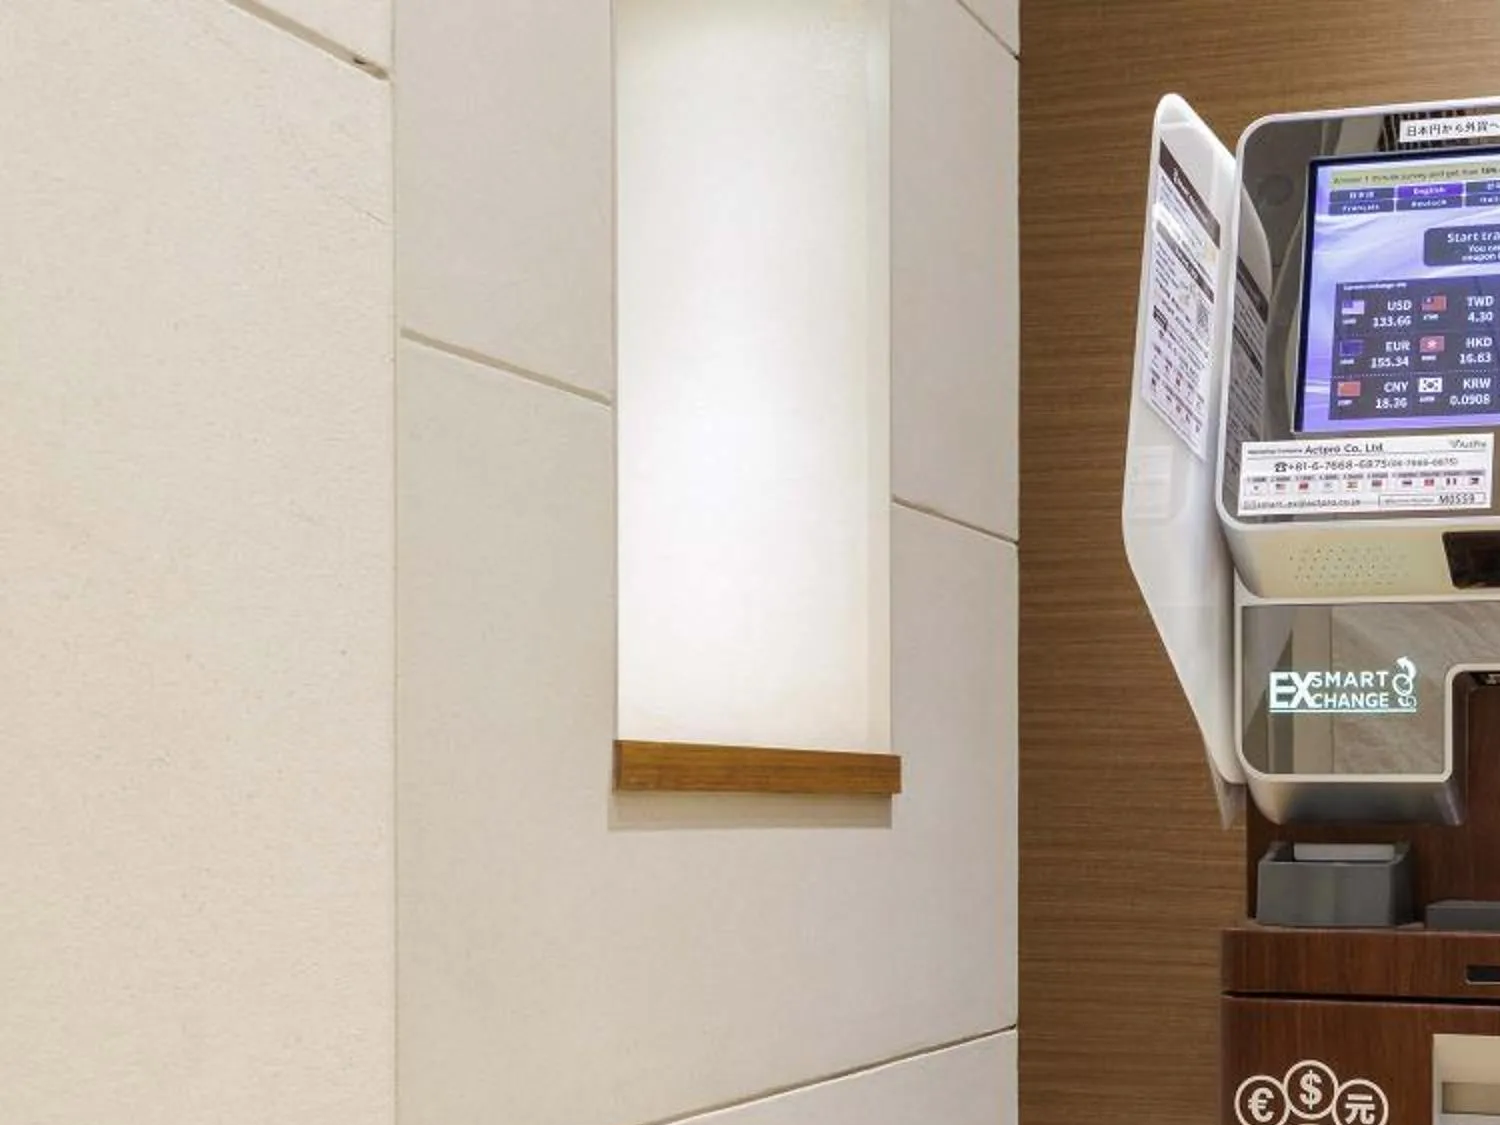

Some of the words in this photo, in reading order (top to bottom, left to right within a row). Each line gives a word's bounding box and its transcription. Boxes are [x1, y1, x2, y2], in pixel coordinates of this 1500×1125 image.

[1447, 231, 1479, 244] Start
[1387, 299, 1413, 311] USD
[1465, 295, 1494, 307] TWD
[1385, 340, 1411, 352] EUR
[1465, 336, 1493, 348] HKD
[1383, 380, 1409, 393] CNY
[1463, 377, 1492, 389] KRW
[1304, 444, 1341, 456] Actpro
[1310, 671, 1390, 688] SMART
